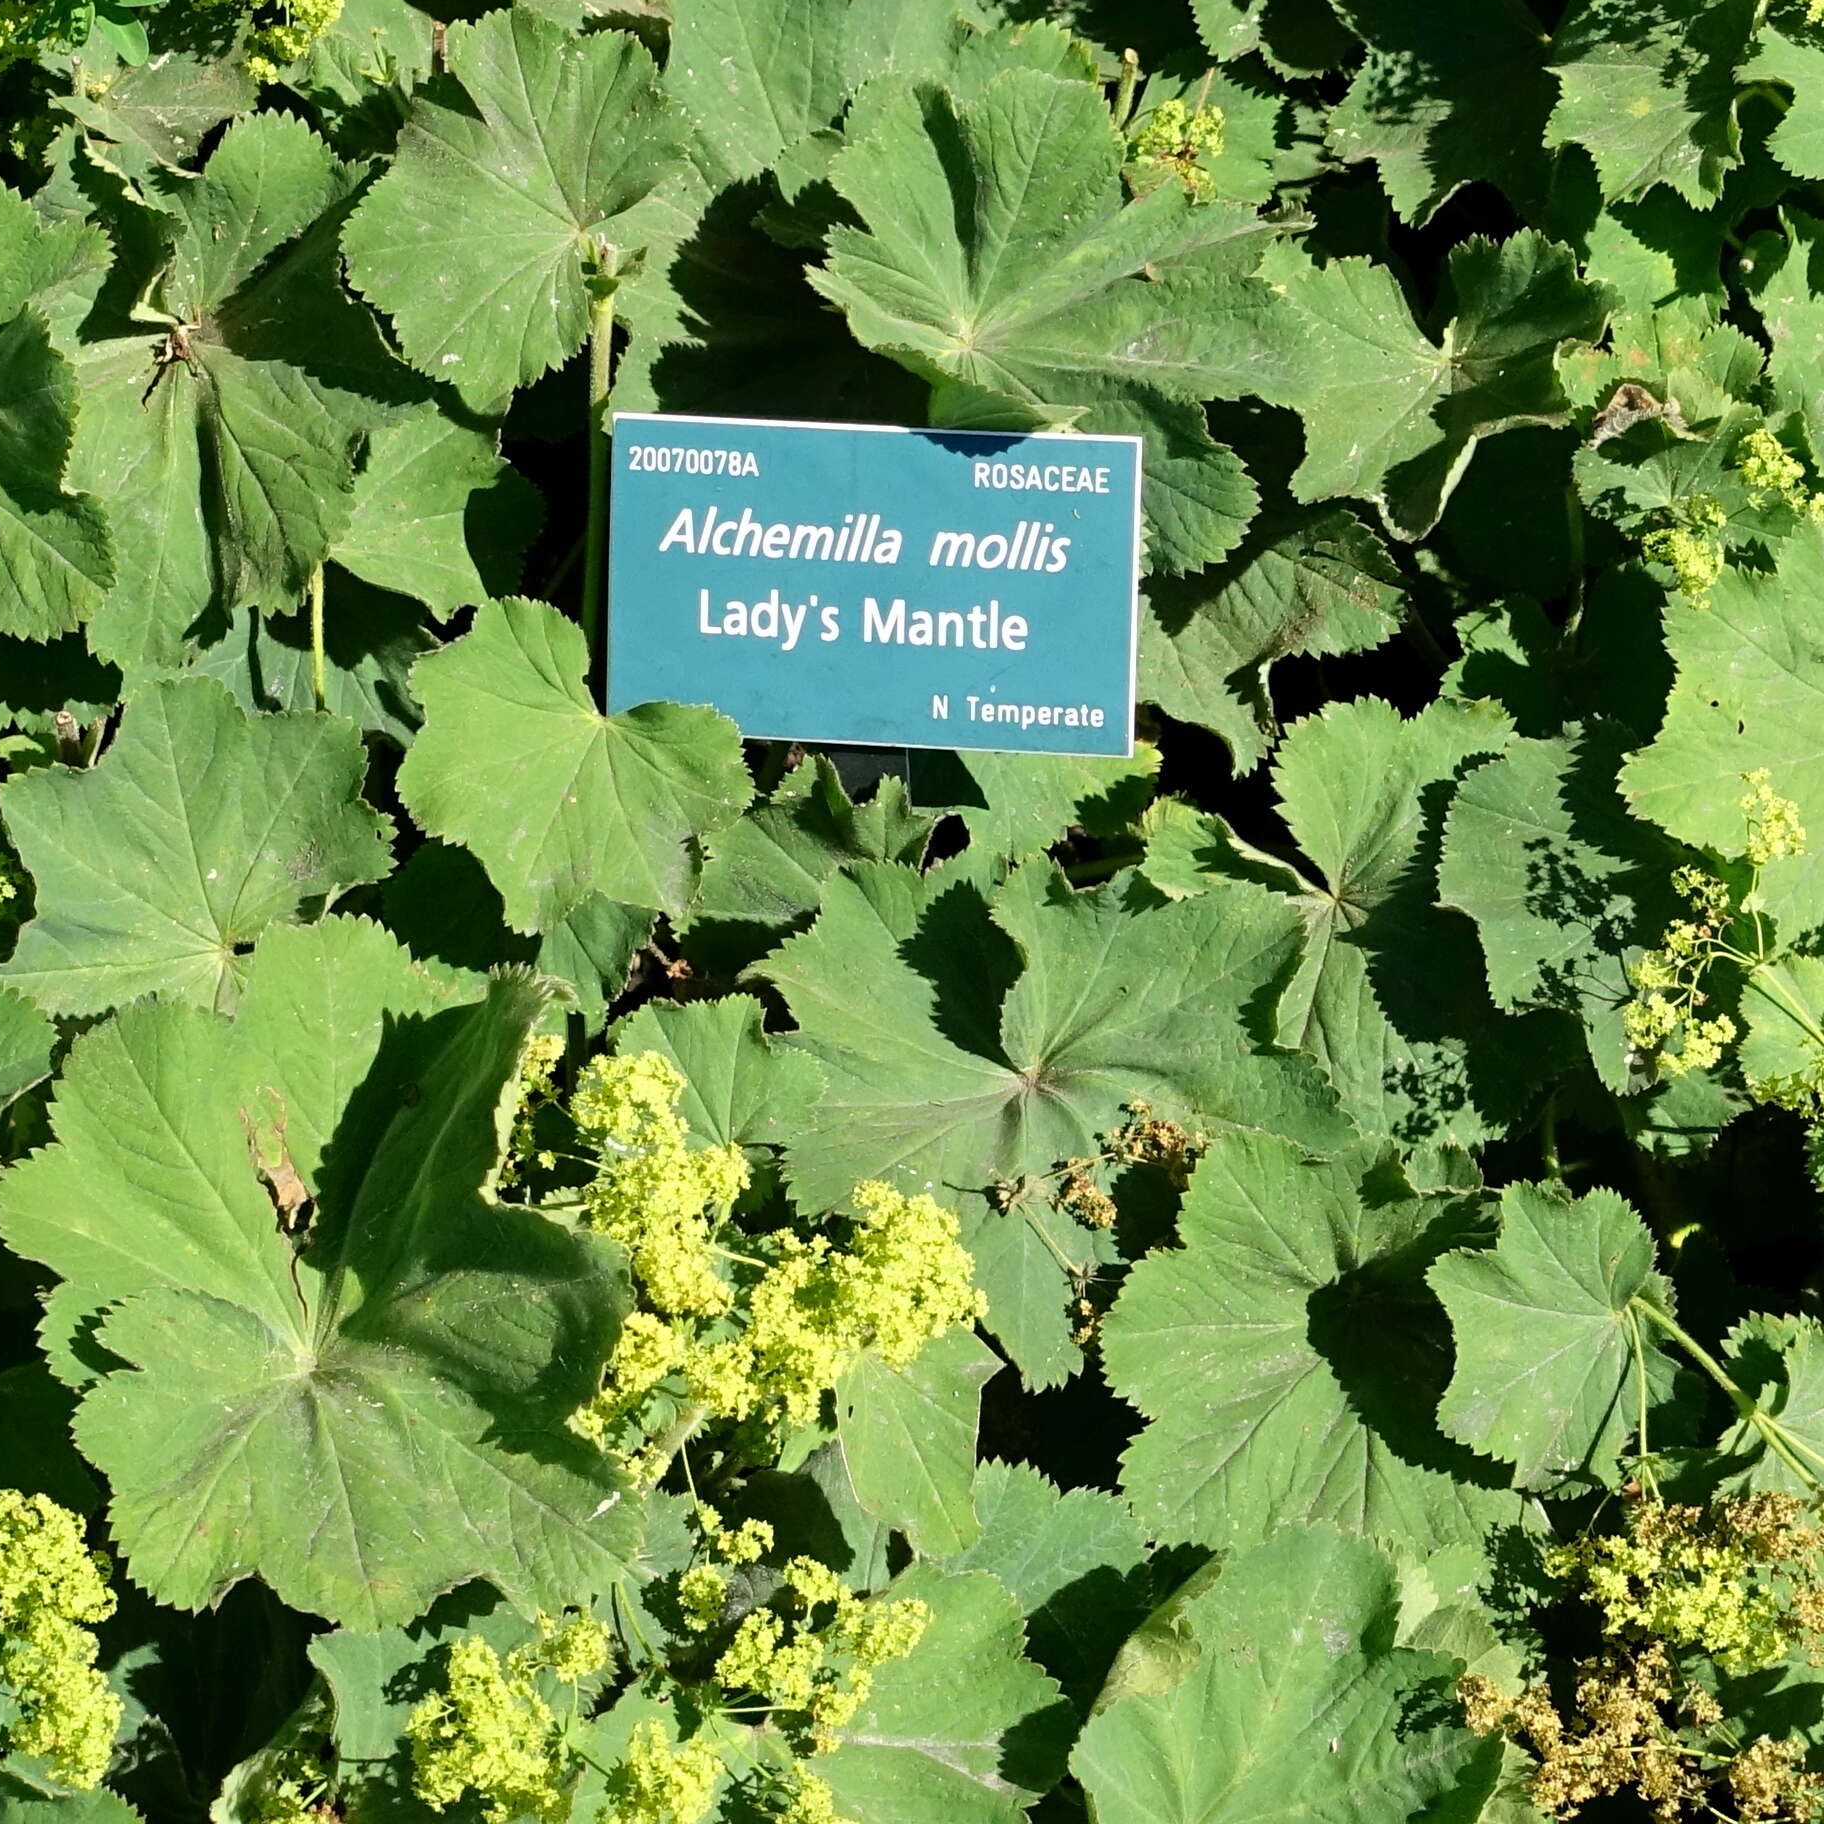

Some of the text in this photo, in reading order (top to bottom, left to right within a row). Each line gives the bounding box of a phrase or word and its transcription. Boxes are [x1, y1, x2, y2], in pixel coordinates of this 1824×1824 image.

[629, 446, 759, 477] 20070078A
[974, 462, 1110, 493] ROSACEAE
[659, 506, 1071, 572] Alchemilla mollis
[699, 589, 1029, 650] Lady's Mantle
[932, 695, 1104, 730] N Temperate
